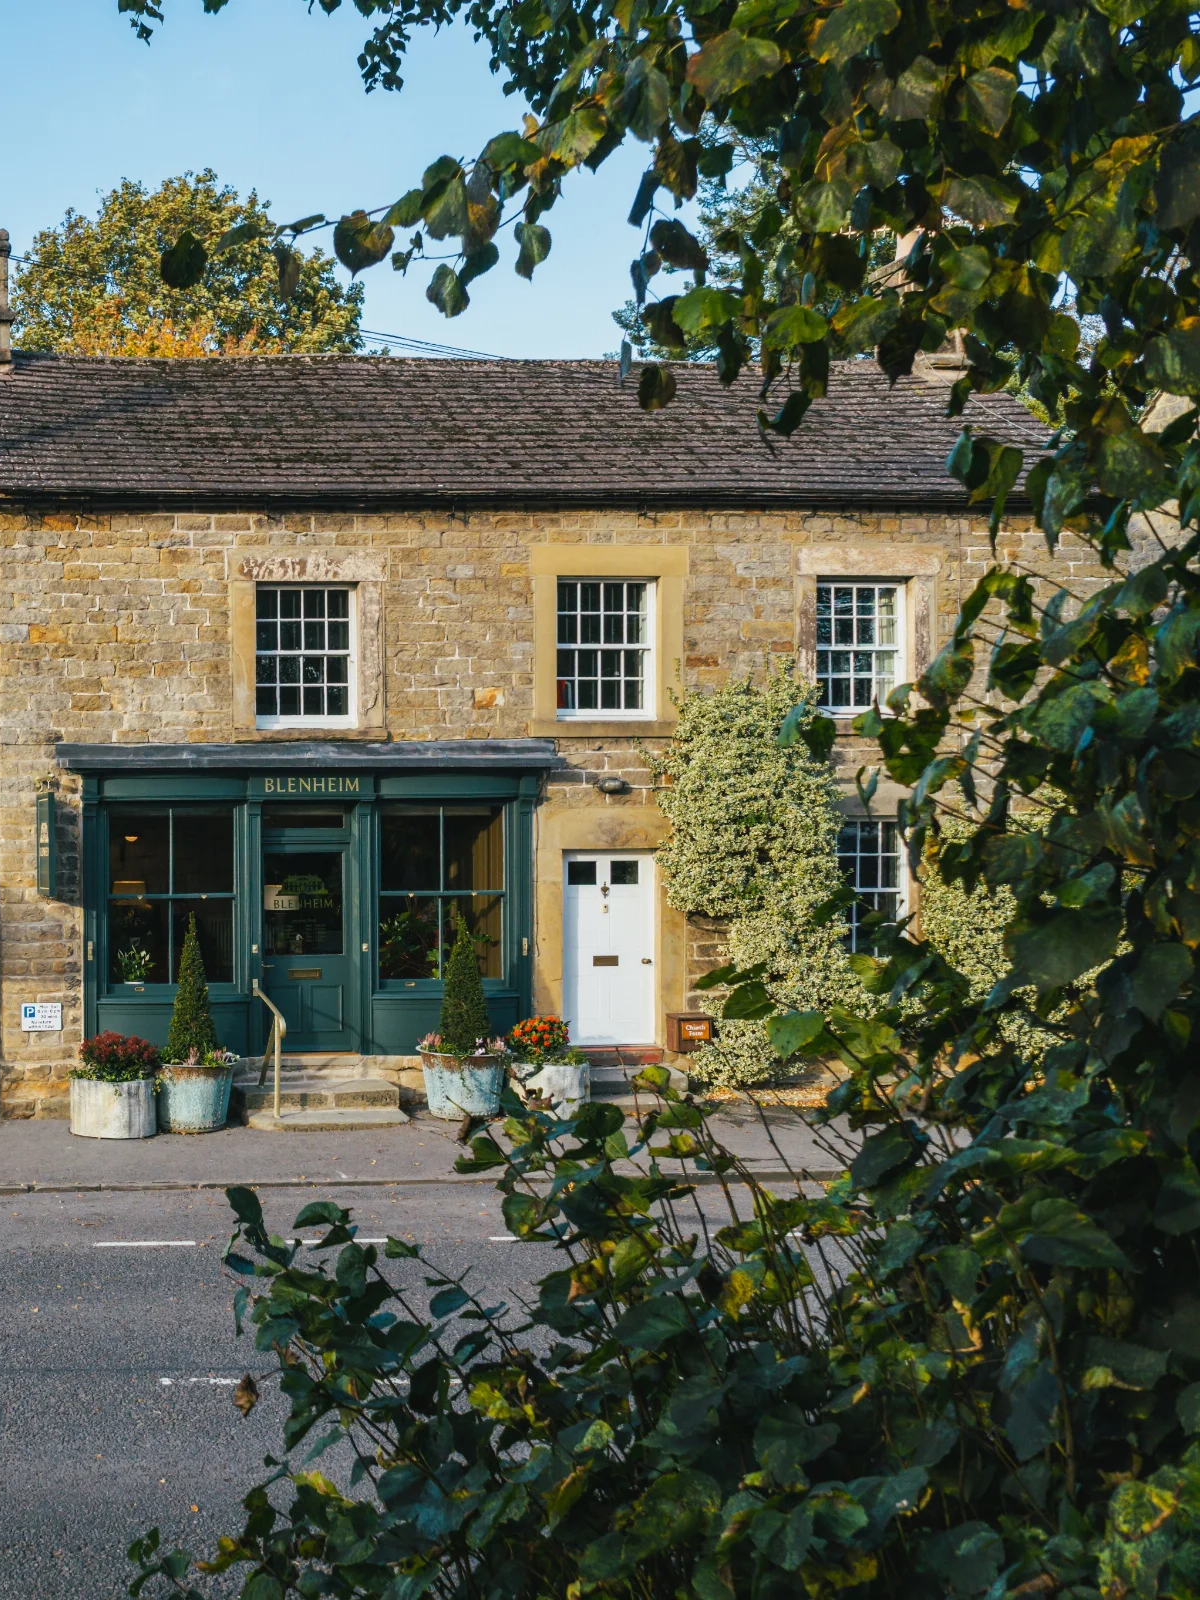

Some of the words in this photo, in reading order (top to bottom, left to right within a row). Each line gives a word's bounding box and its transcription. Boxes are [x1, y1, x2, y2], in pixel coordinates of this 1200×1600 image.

[264, 777, 360, 793] BLENHEIM
[273, 899, 333, 909] BLENHEIM
[26, 1008, 34, 1018] P
